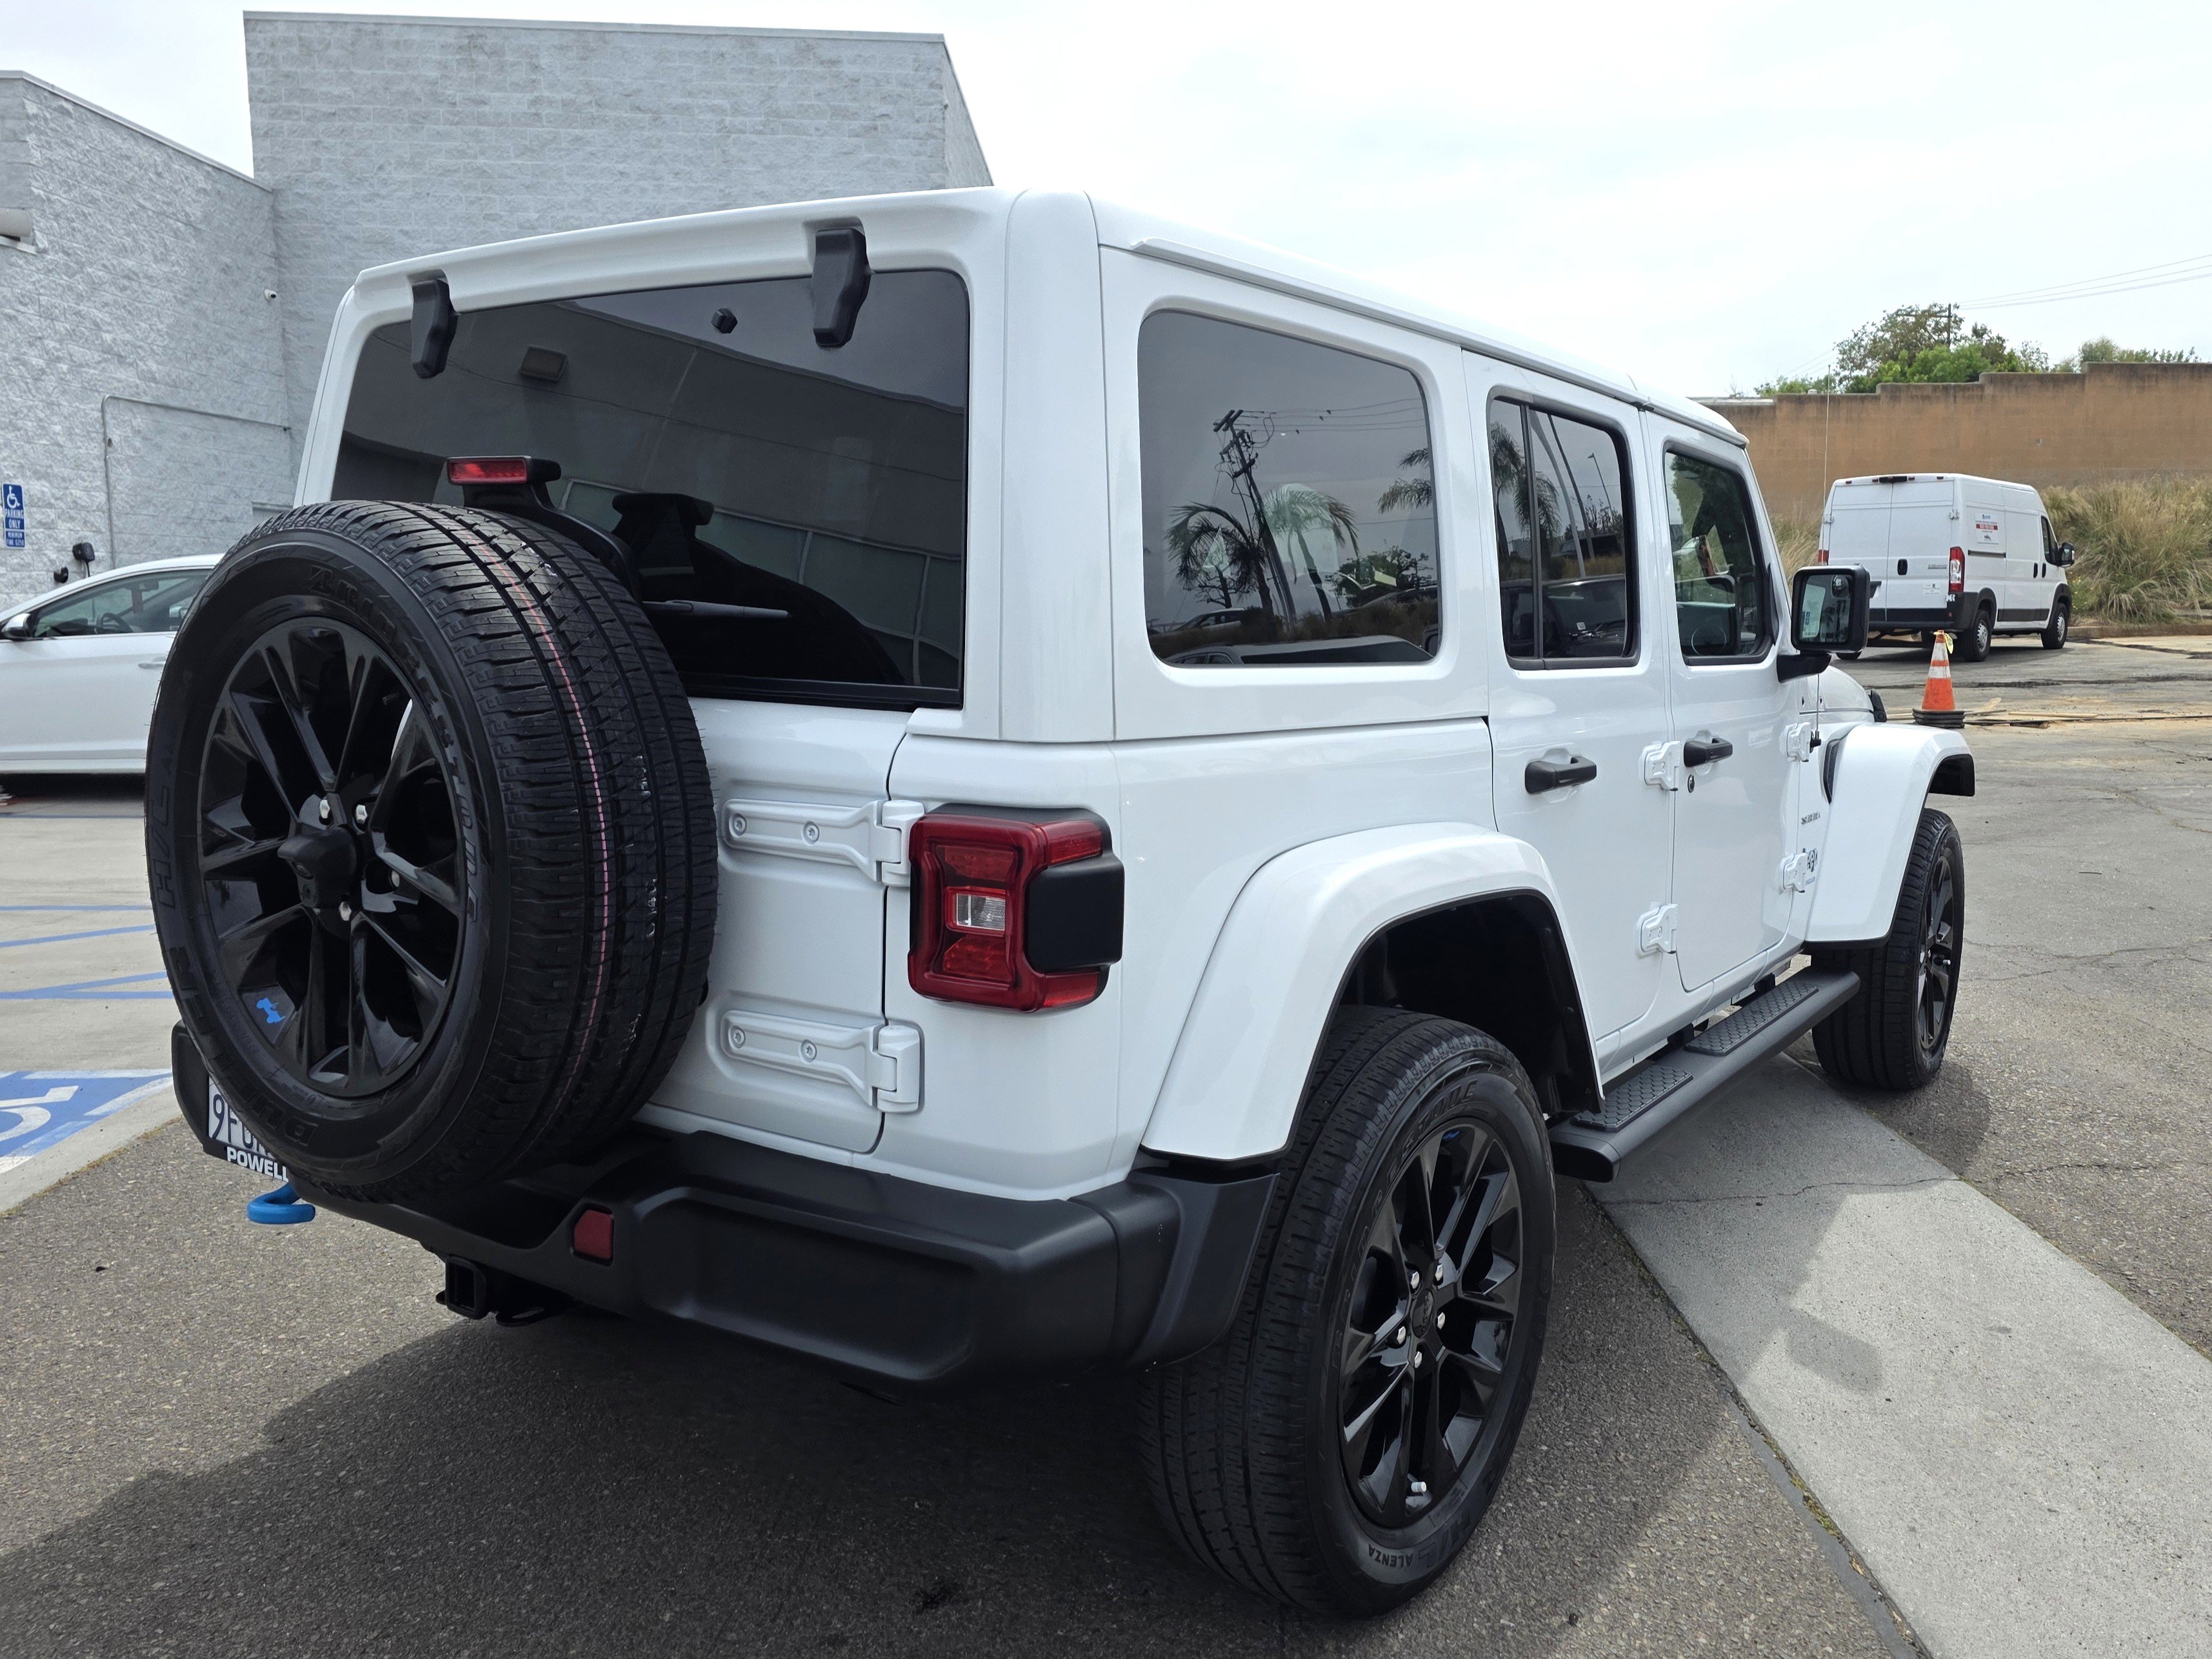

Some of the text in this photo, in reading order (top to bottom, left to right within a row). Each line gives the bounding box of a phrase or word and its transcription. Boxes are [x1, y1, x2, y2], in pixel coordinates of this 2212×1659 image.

[5, 508, 24, 519] PARKING
[8, 519, 21, 528] ONLY
[226, 1146, 289, 1182] POWELL
[1368, 1543, 1415, 1568] ALENZA
